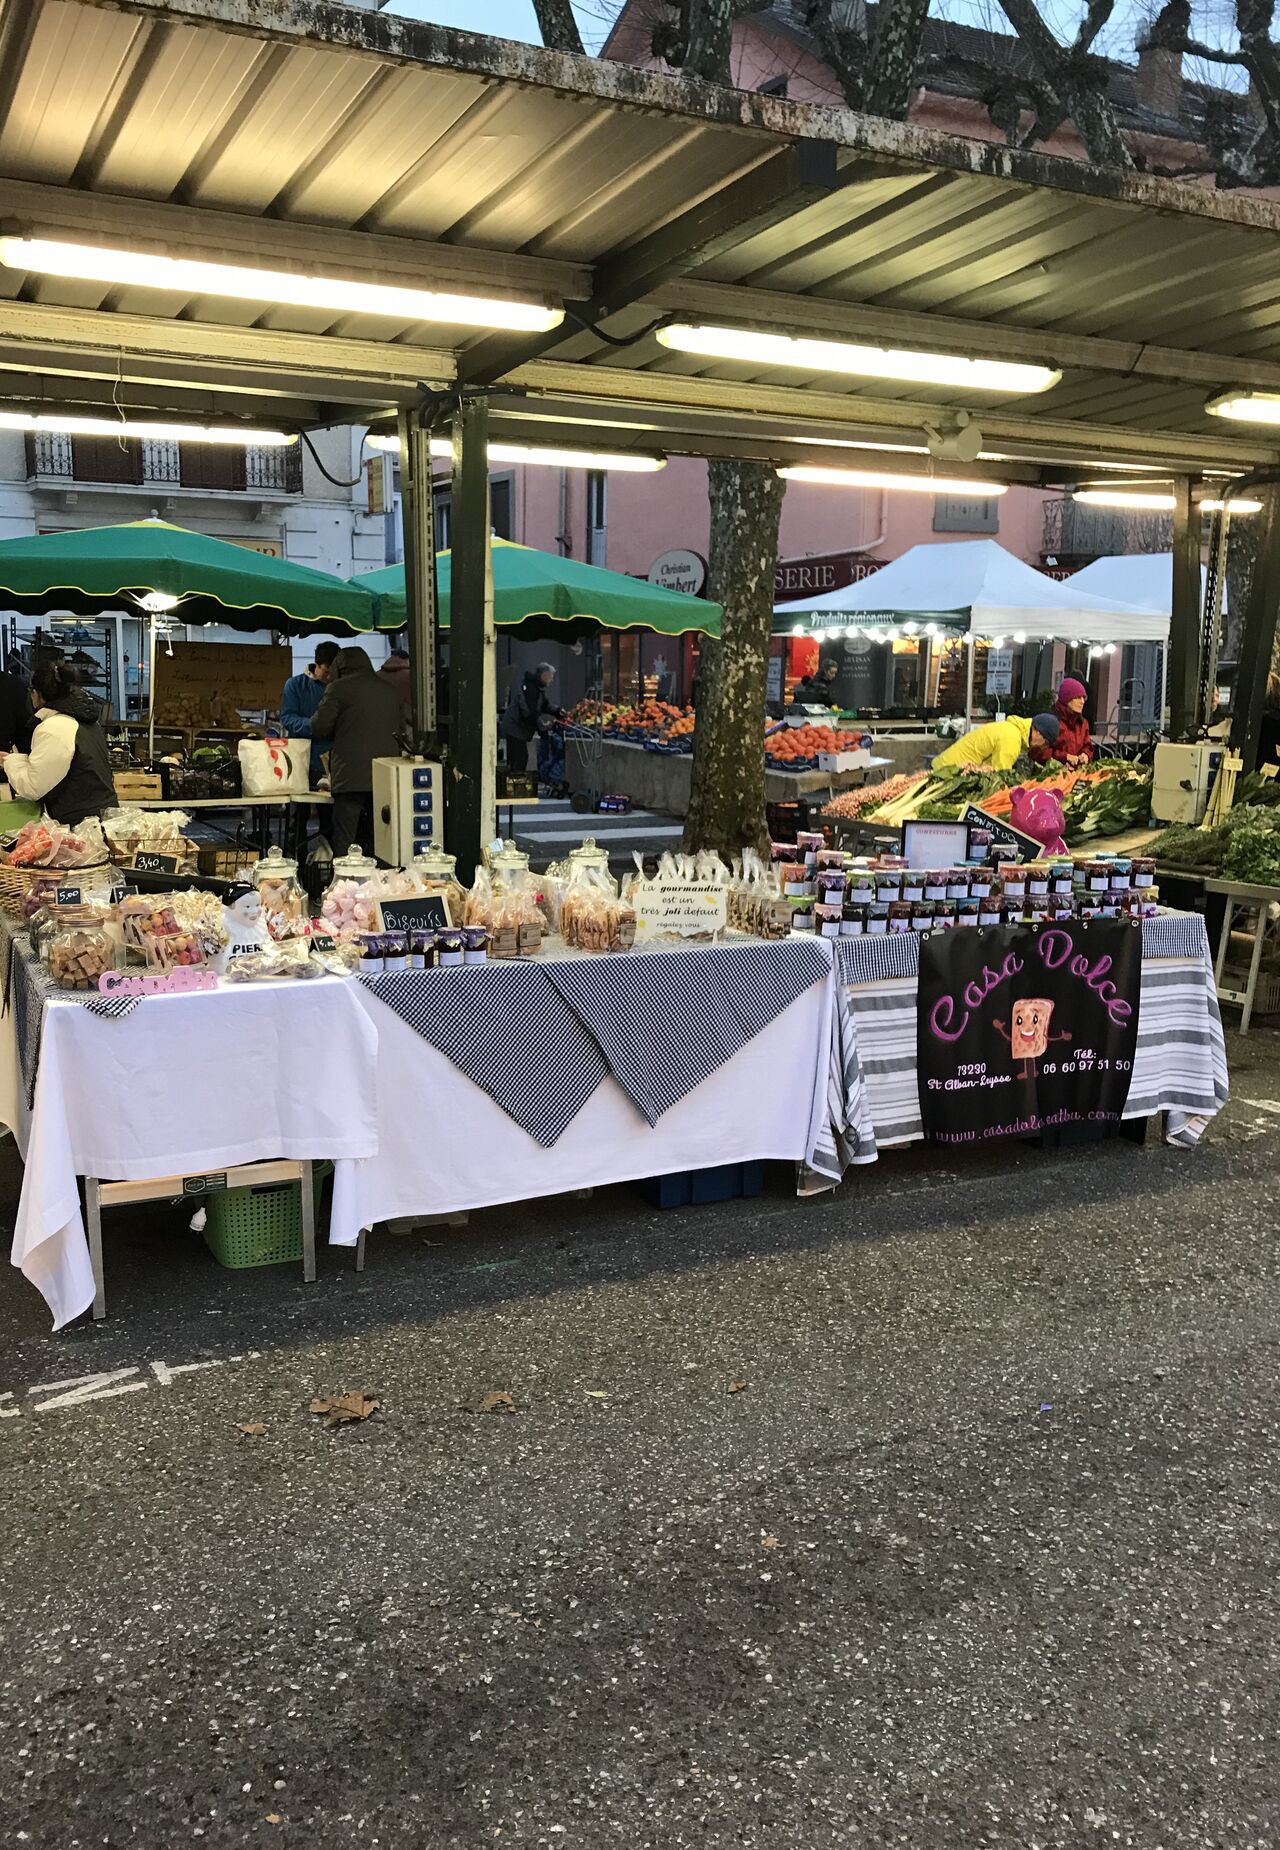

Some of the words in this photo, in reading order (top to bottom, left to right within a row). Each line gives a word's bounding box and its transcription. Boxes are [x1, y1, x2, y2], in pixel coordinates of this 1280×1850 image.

[661, 562, 691, 575] Christian
[774, 565, 836, 590] SERIE
[810, 610, 847, 627] Produits
[848, 610, 895, 625] régionaux
[137, 856, 160, 870] 3,40
[642, 883, 656, 892] La
[58, 889, 79, 902] 5,00
[662, 896, 677, 904] est
[663, 907, 681, 917] joli
[383, 909, 442, 931] Biscuits
[232, 943, 263, 954] PIER
[929, 951, 1024, 1041] Casa
[1038, 929, 1133, 1029] Dolce
[1073, 1048, 1097, 1060] Tél:
[1043, 1062, 1057, 1075] 06
[1061, 1061, 1076, 1073] 60
[1078, 1060, 1094, 1071] 97
[1097, 1059, 1109, 1070] 51
[1115, 1059, 1131, 1071] 50
[927, 1078, 943, 1090] St
